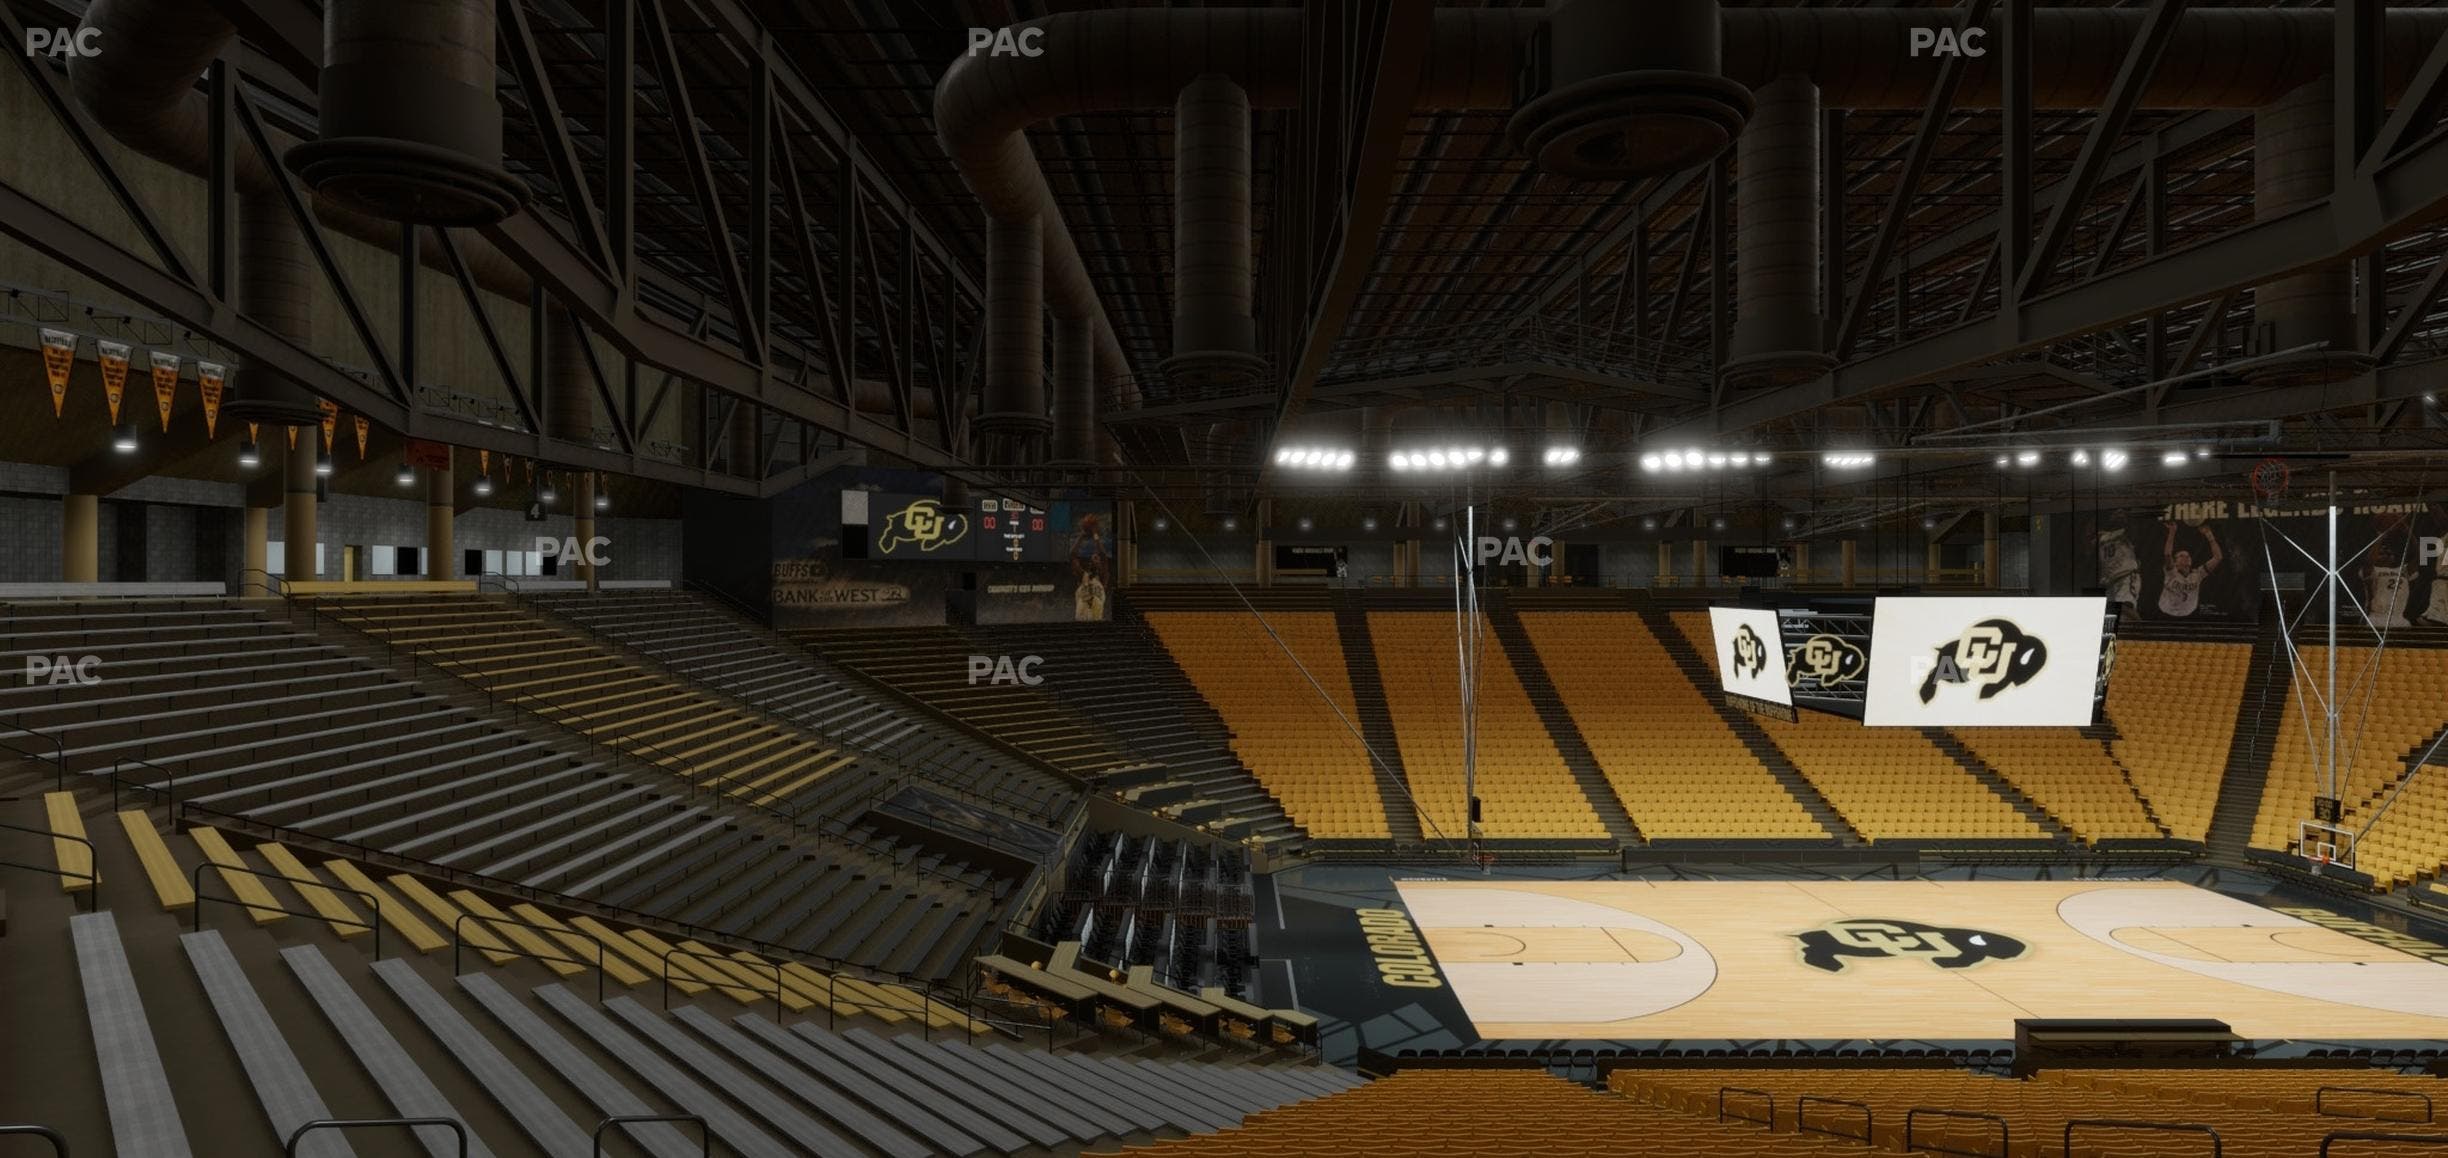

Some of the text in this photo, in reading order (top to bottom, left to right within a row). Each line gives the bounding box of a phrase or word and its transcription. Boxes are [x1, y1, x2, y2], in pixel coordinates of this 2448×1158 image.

[530, 503, 539, 518] 4
[774, 563, 808, 577] BUFFS
[772, 589, 818, 603] BANK
[835, 588, 879, 602] WEST
[1806, 640, 1842, 674] CU
[1957, 627, 2019, 684] CU
[1355, 907, 1443, 988] COLORADO
[1825, 922, 1963, 958] CU
